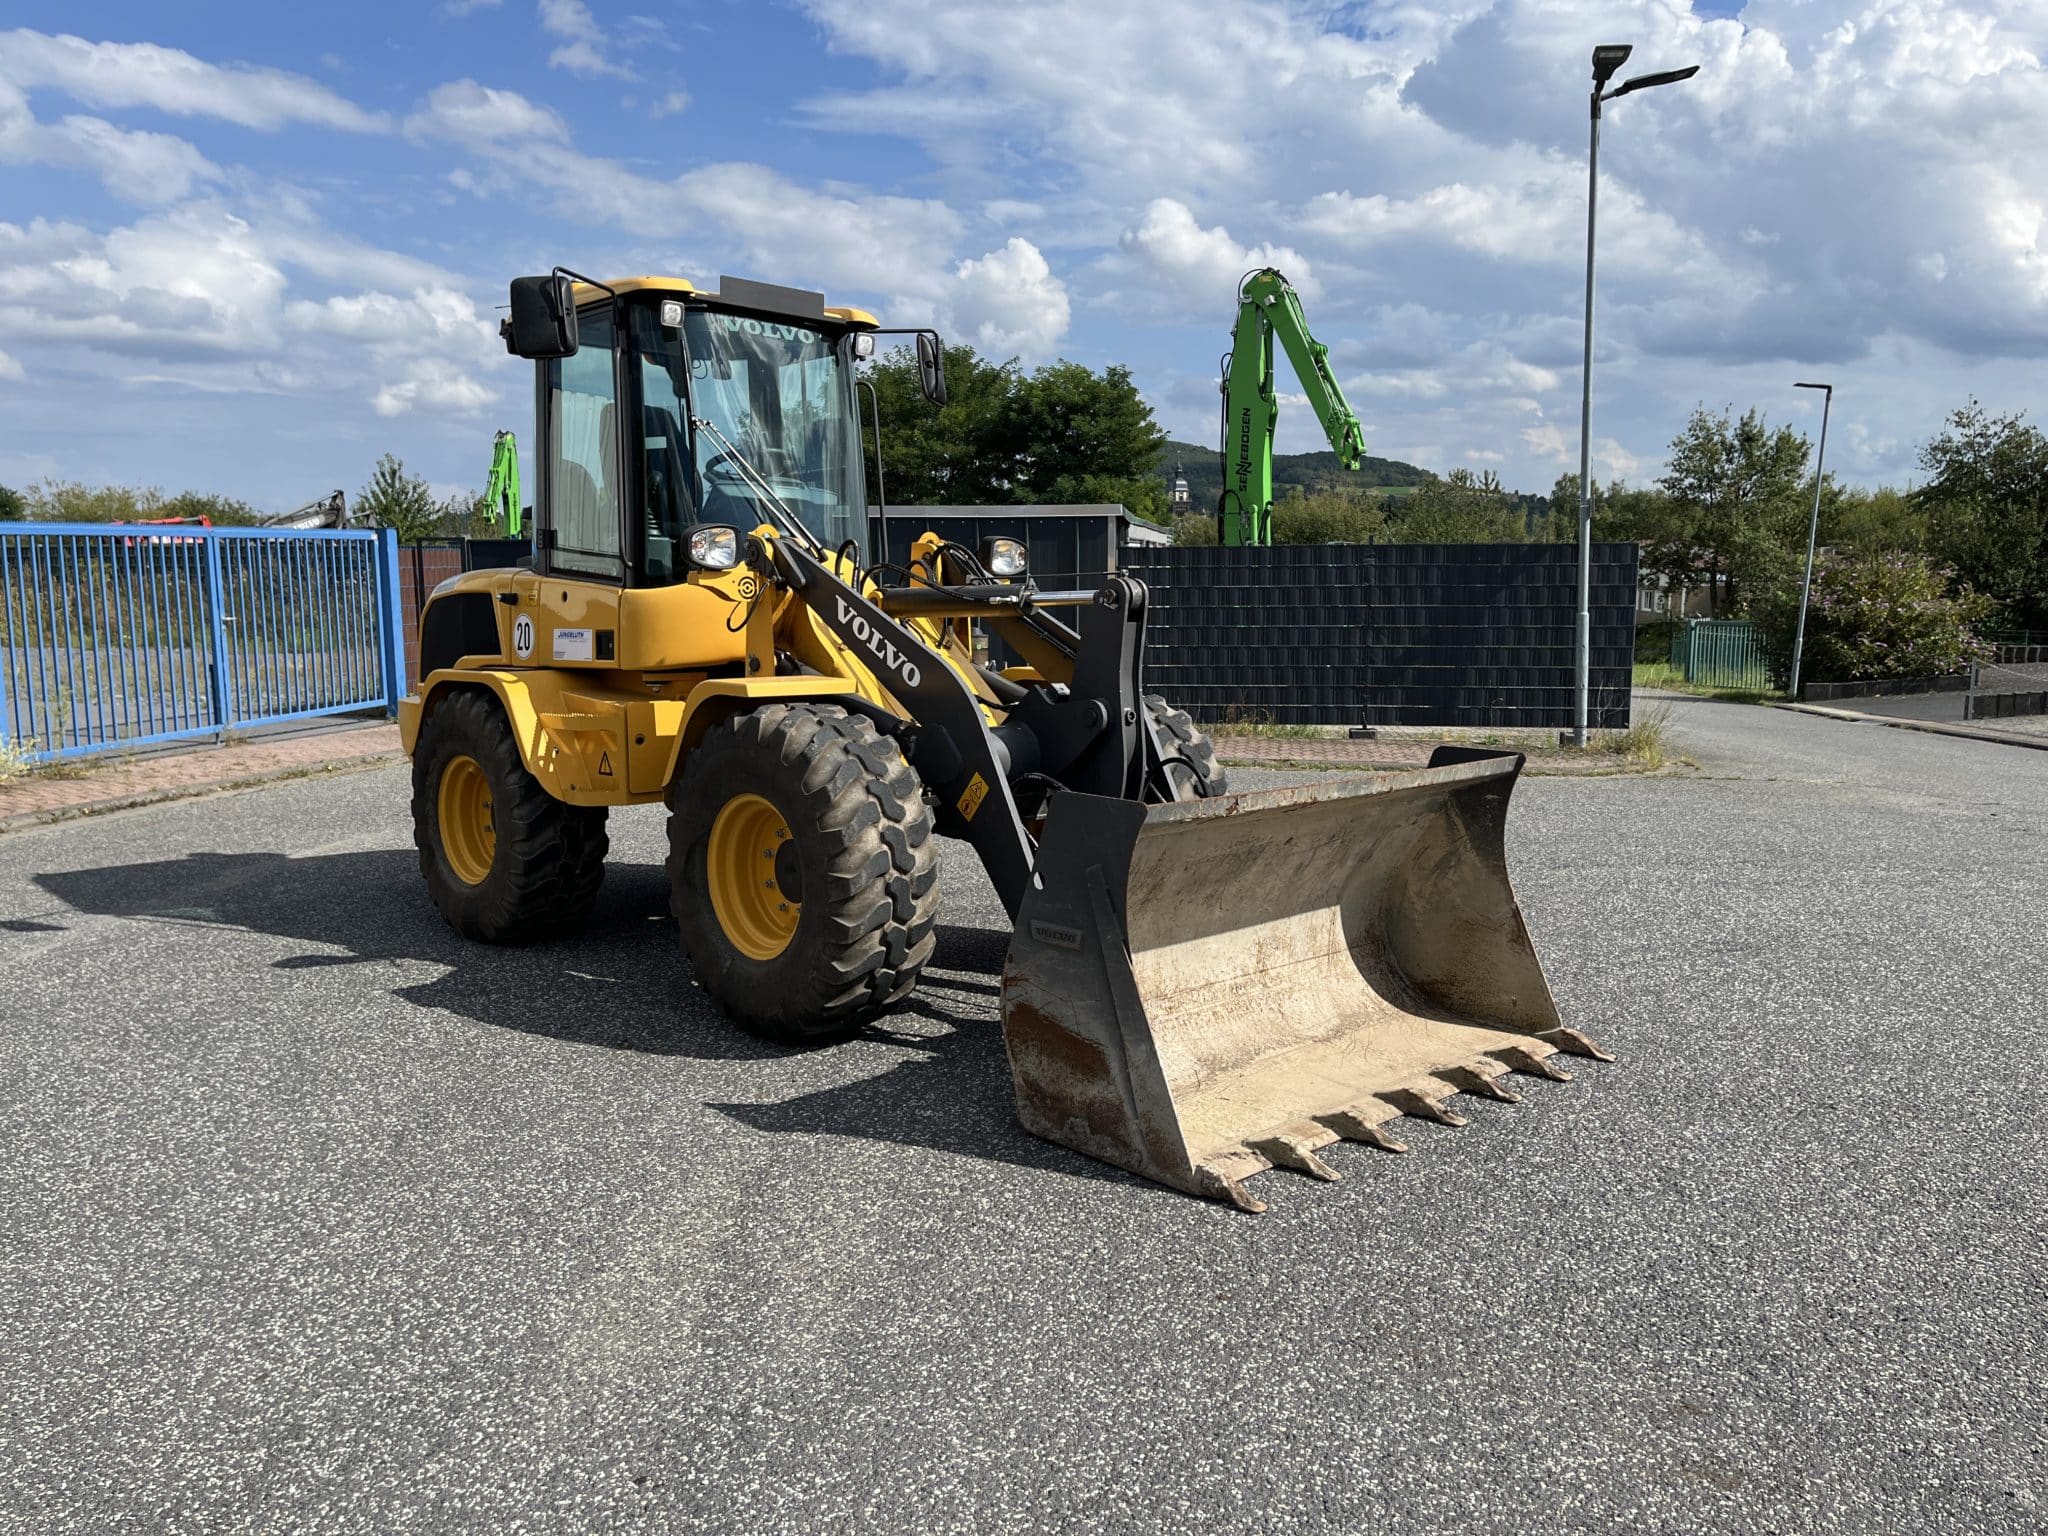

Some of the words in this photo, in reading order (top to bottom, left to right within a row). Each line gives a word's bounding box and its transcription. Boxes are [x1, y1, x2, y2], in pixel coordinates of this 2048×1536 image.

[722, 315, 815, 344] VOLVO
[1236, 407, 1252, 493] SENNEBOGEN
[517, 622, 531, 651] 20
[835, 594, 920, 688] VOLVO
